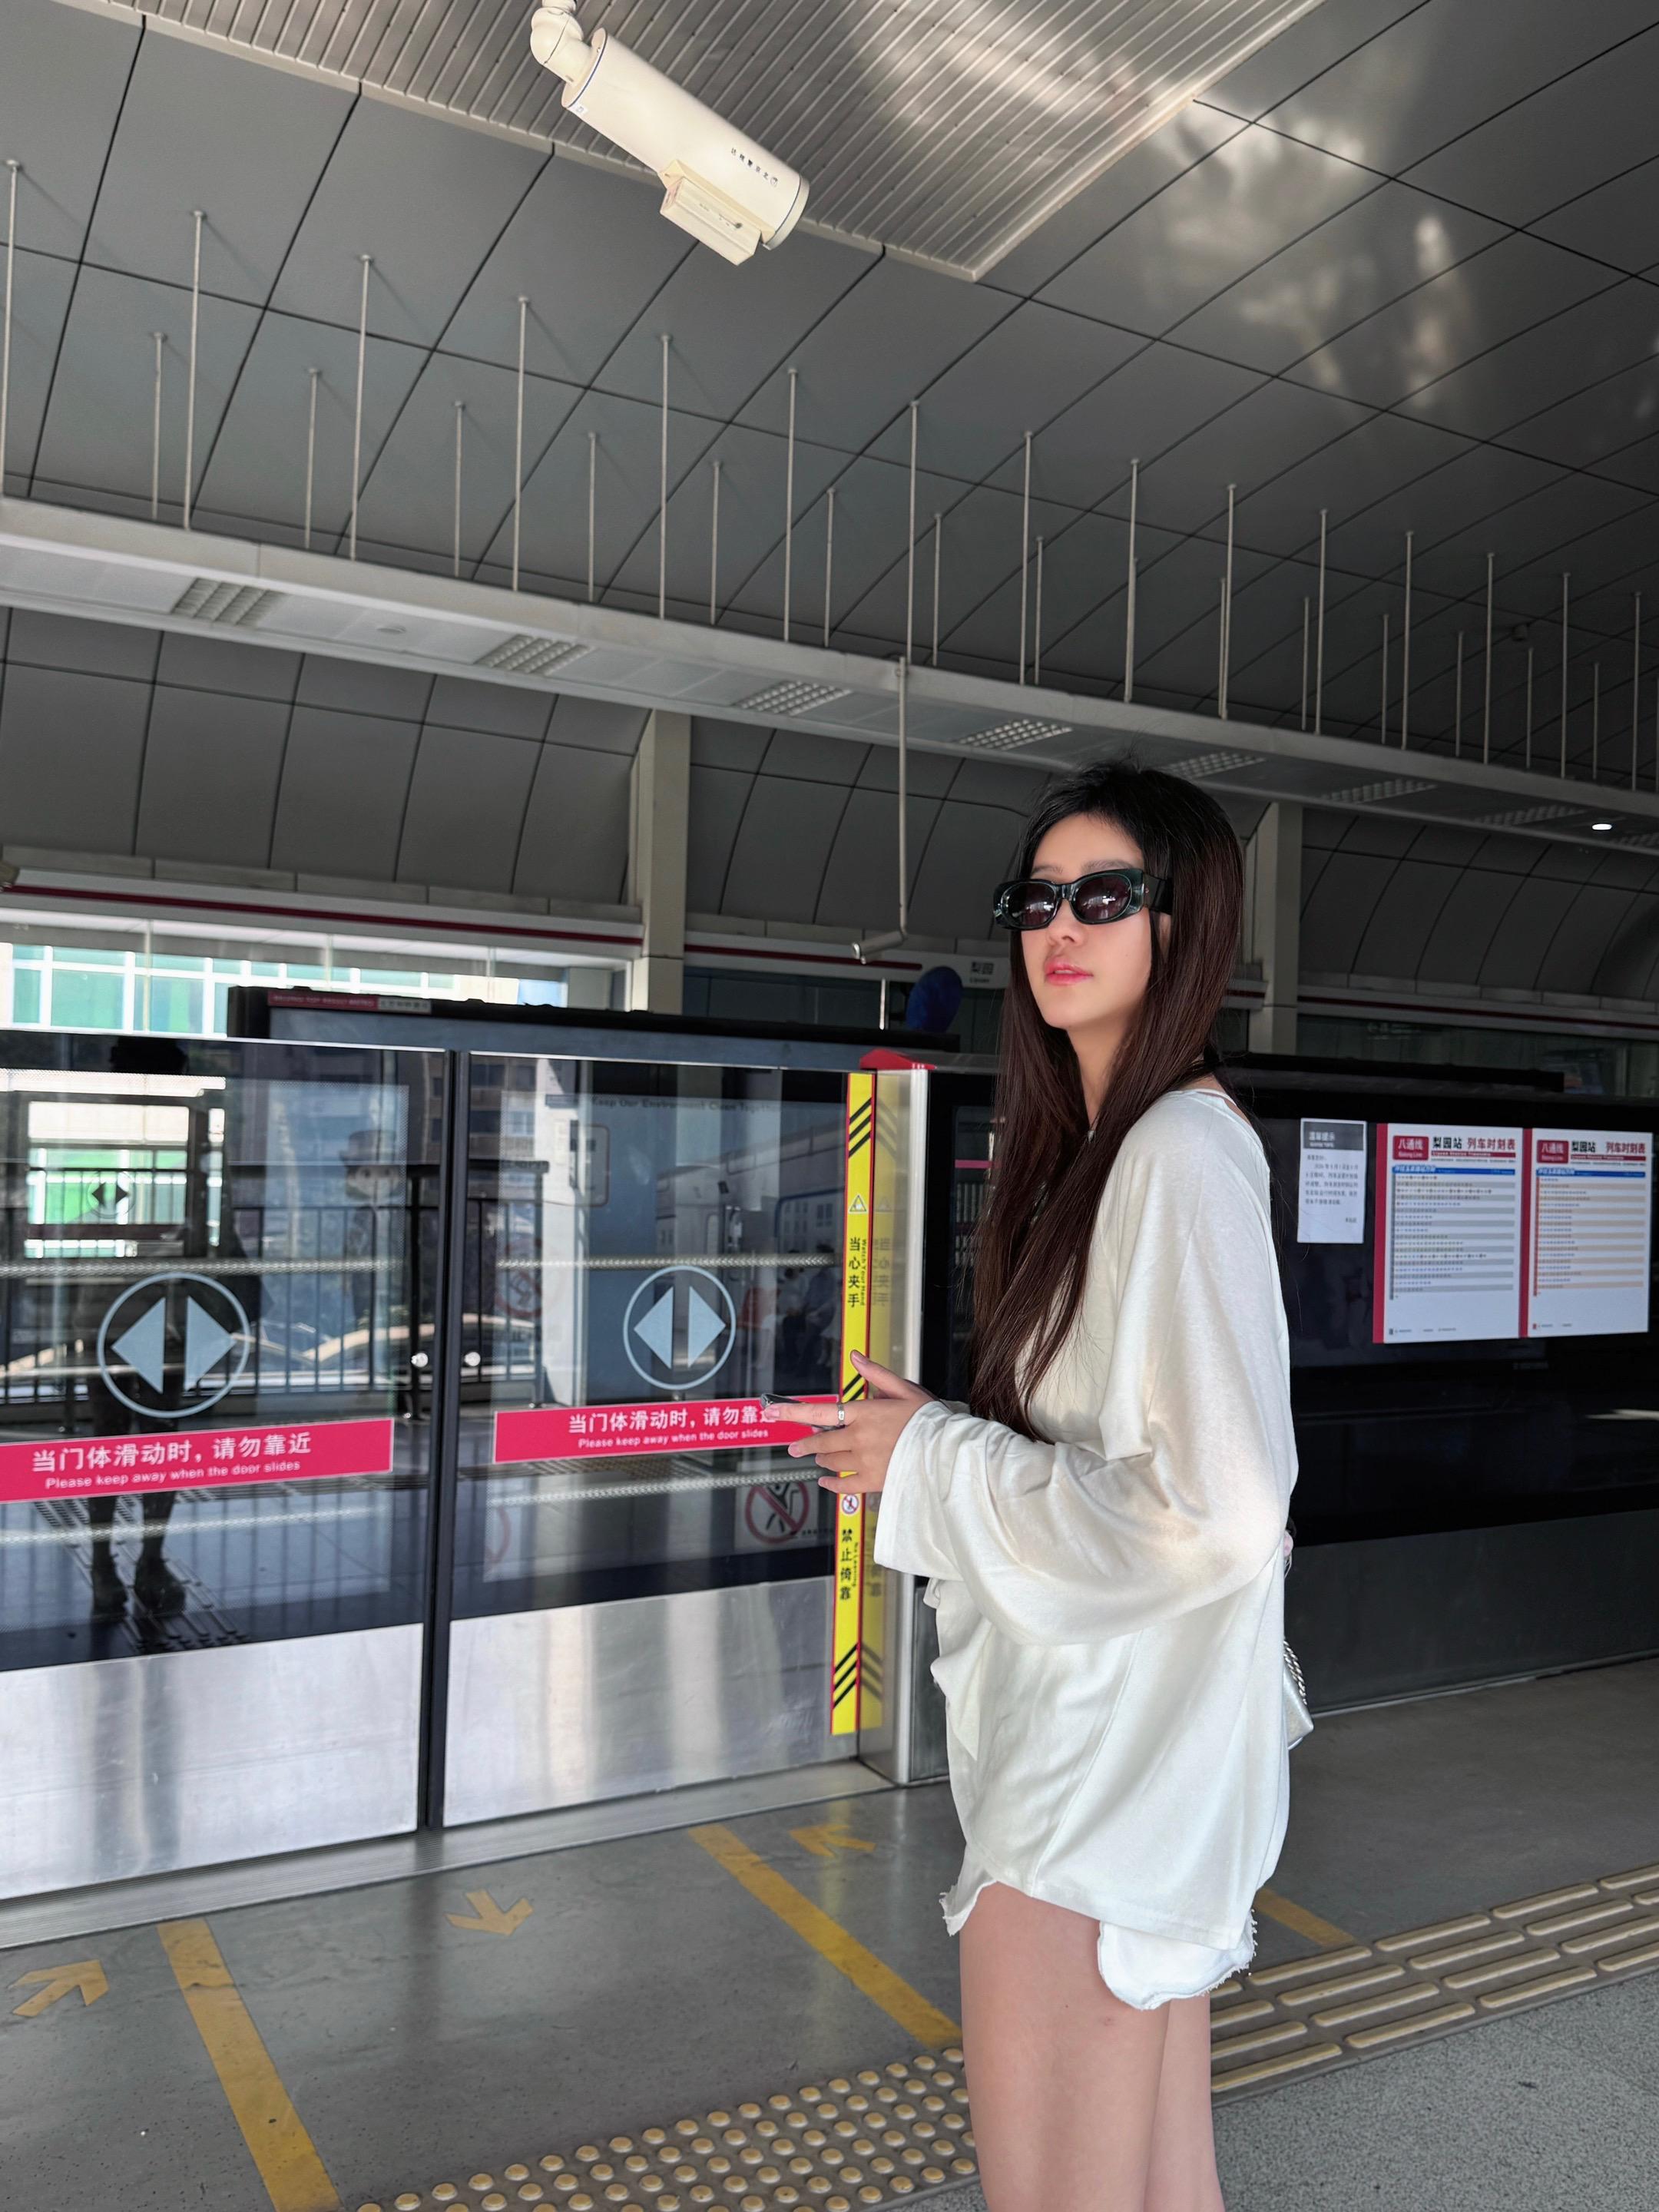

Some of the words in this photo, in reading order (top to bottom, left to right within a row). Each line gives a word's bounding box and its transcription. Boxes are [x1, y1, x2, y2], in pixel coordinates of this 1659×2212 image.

[1432, 1137, 1462, 1149] 梨园站
[1467, 1137, 1515, 1151] 列车时刻表
[1571, 1141, 1596, 1153] 梨园站
[848, 1237, 860, 1308] 当心夹手
[578, 1438, 613, 1449] Please
[616, 1436, 641, 1446] keep
[643, 1435, 669, 1445] away
[671, 1433, 697, 1442] when
[699, 1432, 715, 1441] the
[717, 1430, 739, 1439] door
[741, 1429, 769, 1439] slides
[45, 1476, 92, 1489] Please
[96, 1474, 129, 1487] keep
[132, 1472, 167, 1483] away
[171, 1468, 204, 1480] when
[207, 1465, 228, 1476] the
[232, 1463, 260, 1475] door
[263, 1461, 301, 1472] slides
